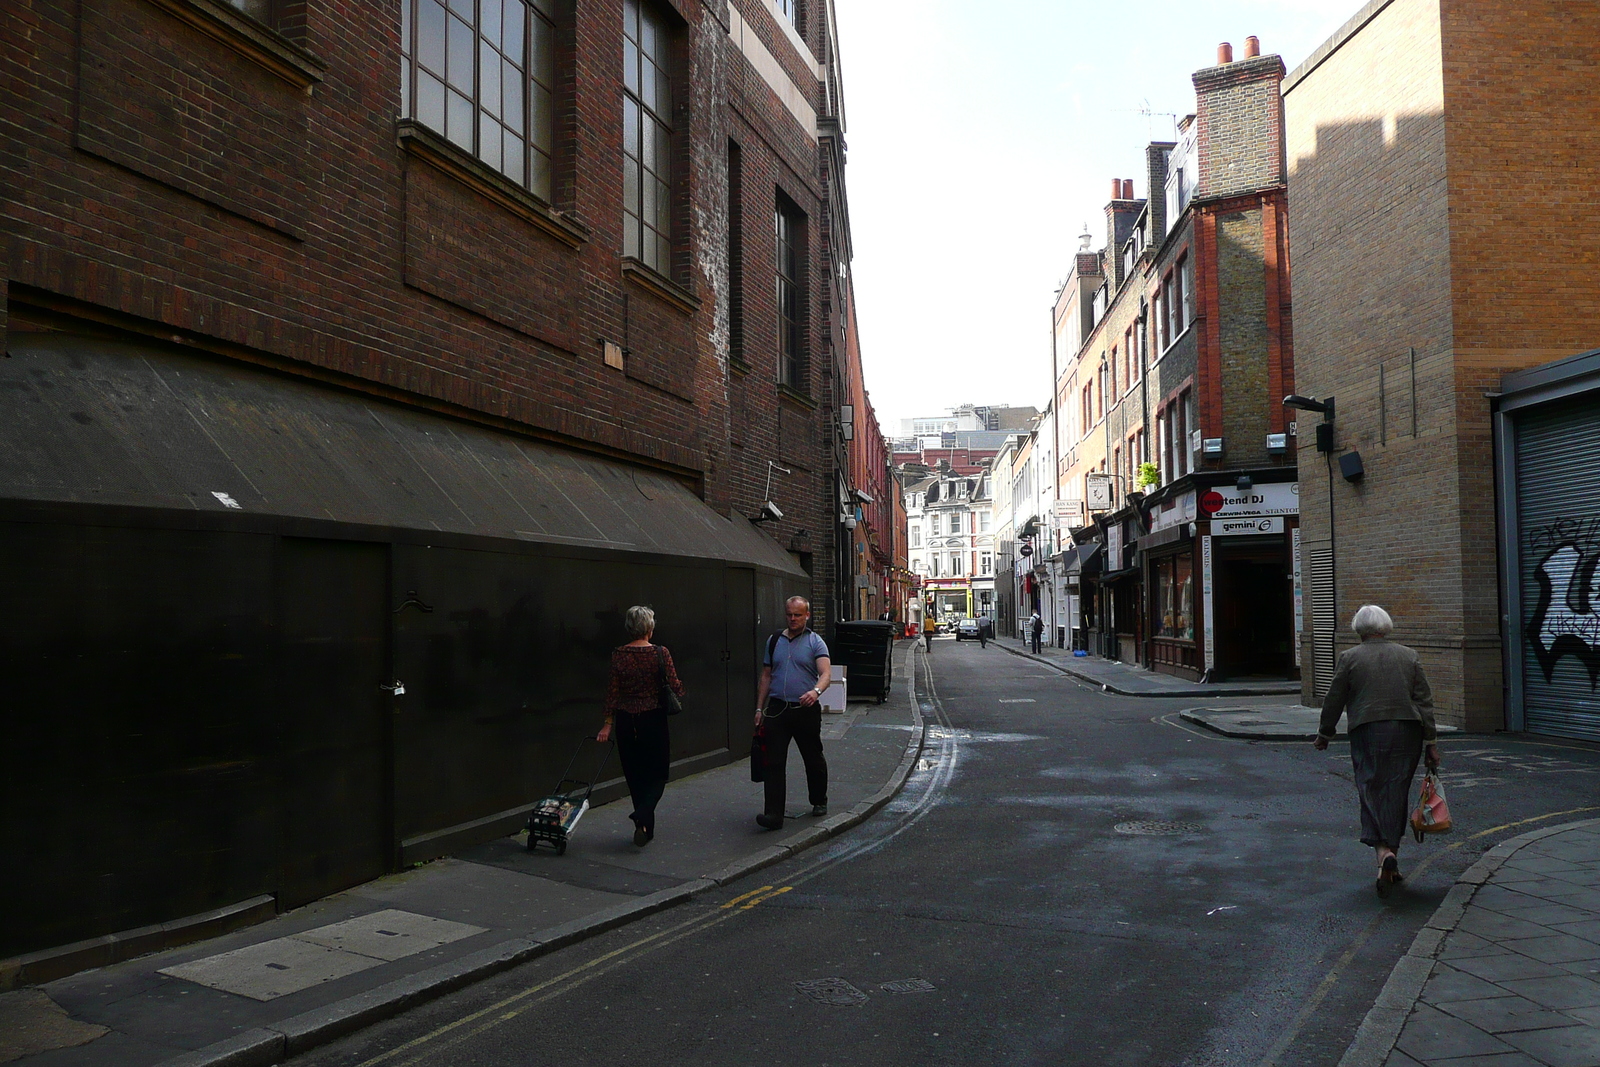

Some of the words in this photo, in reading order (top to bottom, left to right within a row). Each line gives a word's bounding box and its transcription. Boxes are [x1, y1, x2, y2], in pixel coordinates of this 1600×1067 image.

[1203, 495, 1248, 506] westend
[1251, 495, 1264, 504] DJ
[1223, 521, 1256, 531] gemini
